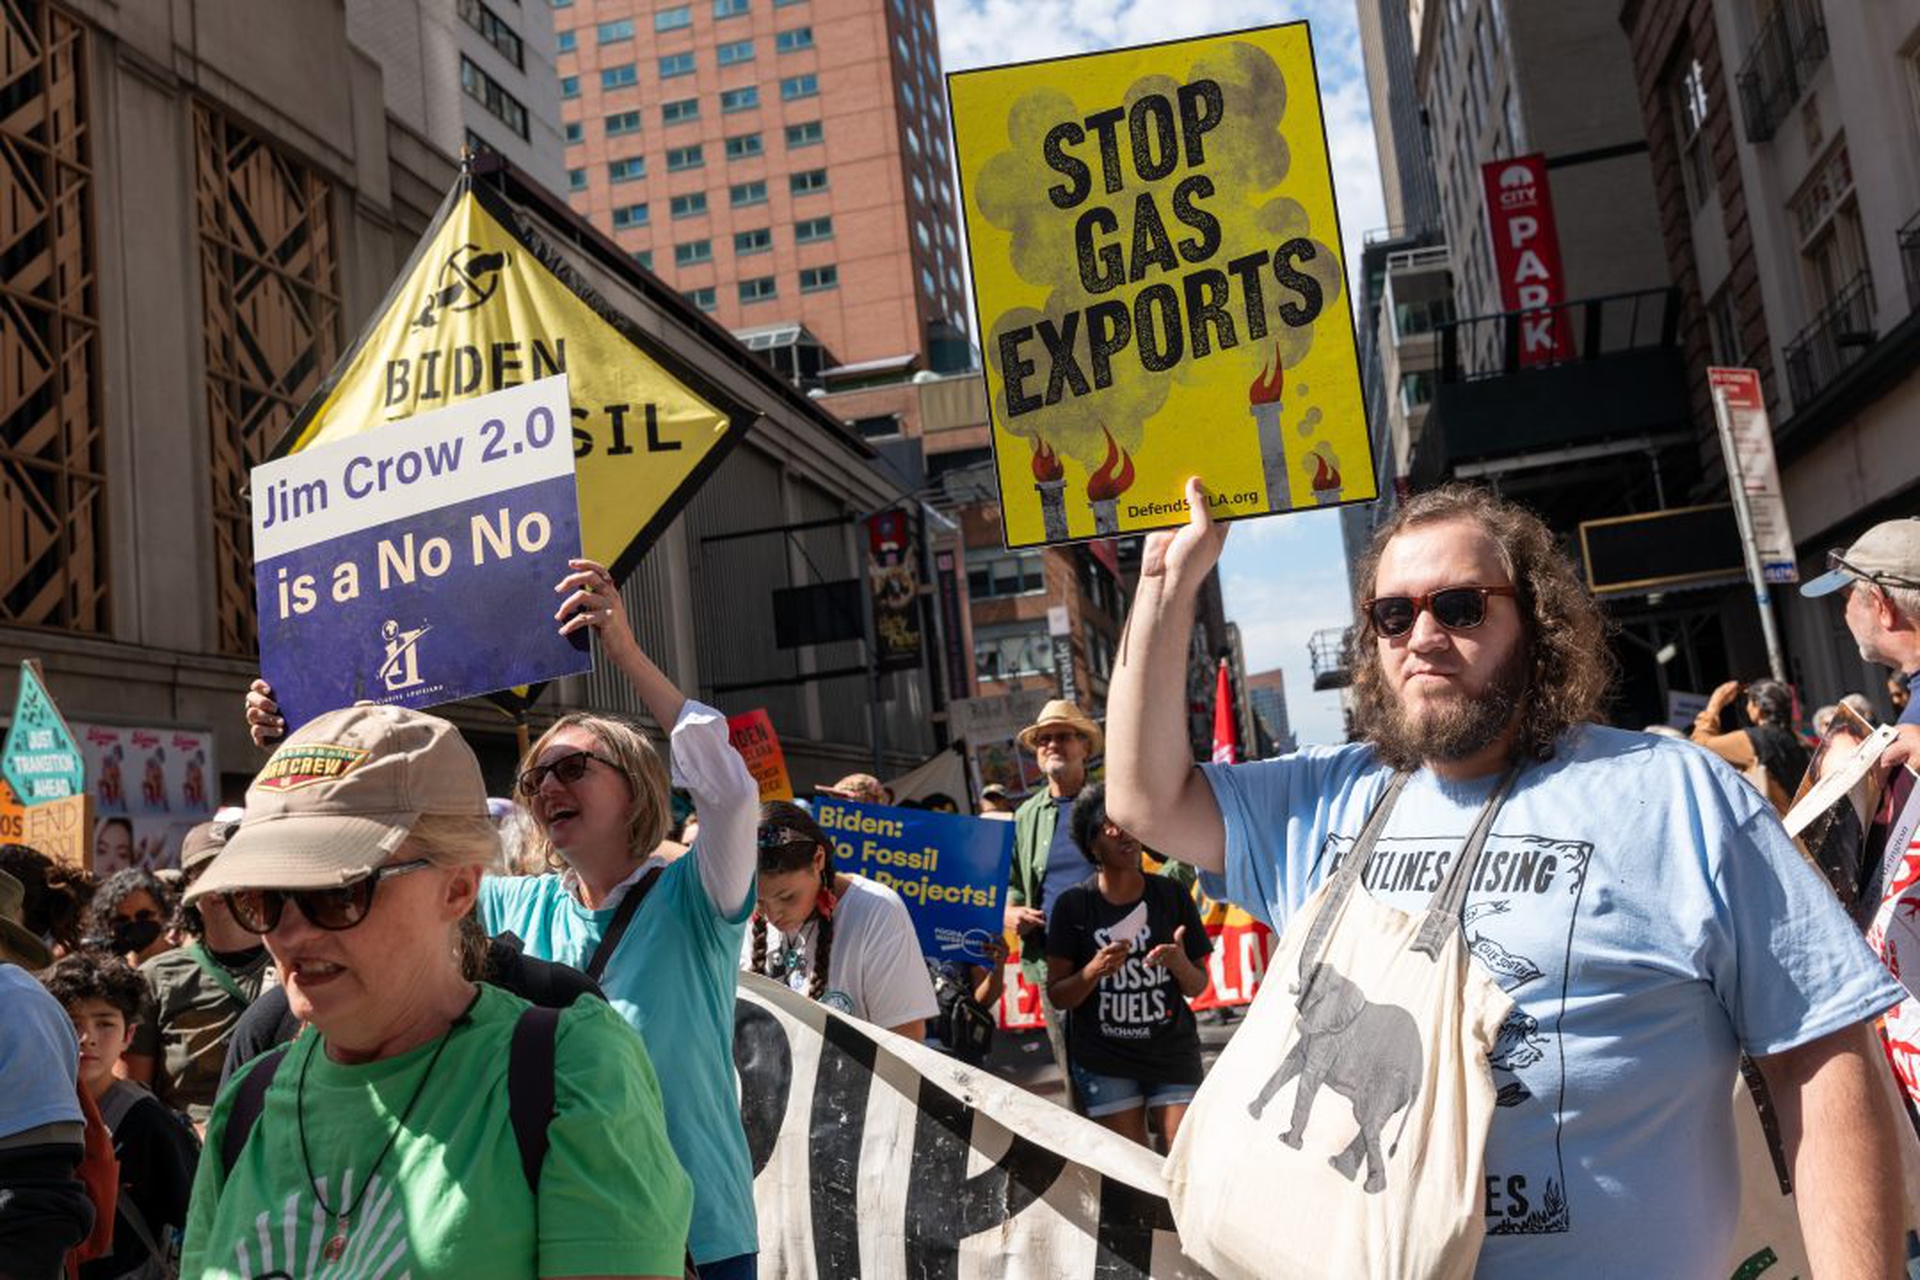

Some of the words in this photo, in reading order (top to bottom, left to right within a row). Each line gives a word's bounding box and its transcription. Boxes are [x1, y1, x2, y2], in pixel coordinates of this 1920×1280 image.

[1043, 78, 1224, 209] STOP
[1074, 175, 1222, 295] GAS
[999, 237, 1323, 418] EXPORTS
[572, 402, 683, 459] SIL
[262, 476, 328, 529] Jim
[343, 436, 464, 500] Crow
[480, 405, 556, 464] 2.0
[278, 568, 317, 619] is
[332, 561, 360, 603] a
[377, 533, 452, 591] No
[470, 508, 552, 567] No
[289, 757, 342, 776] CREW
[819, 806, 904, 838] Biden:
[861, 840, 939, 872] Fossil
[1468, 850, 1558, 894] ISING
[875, 870, 997, 908] Projects!
[1098, 988, 1173, 1023] FUELS.
